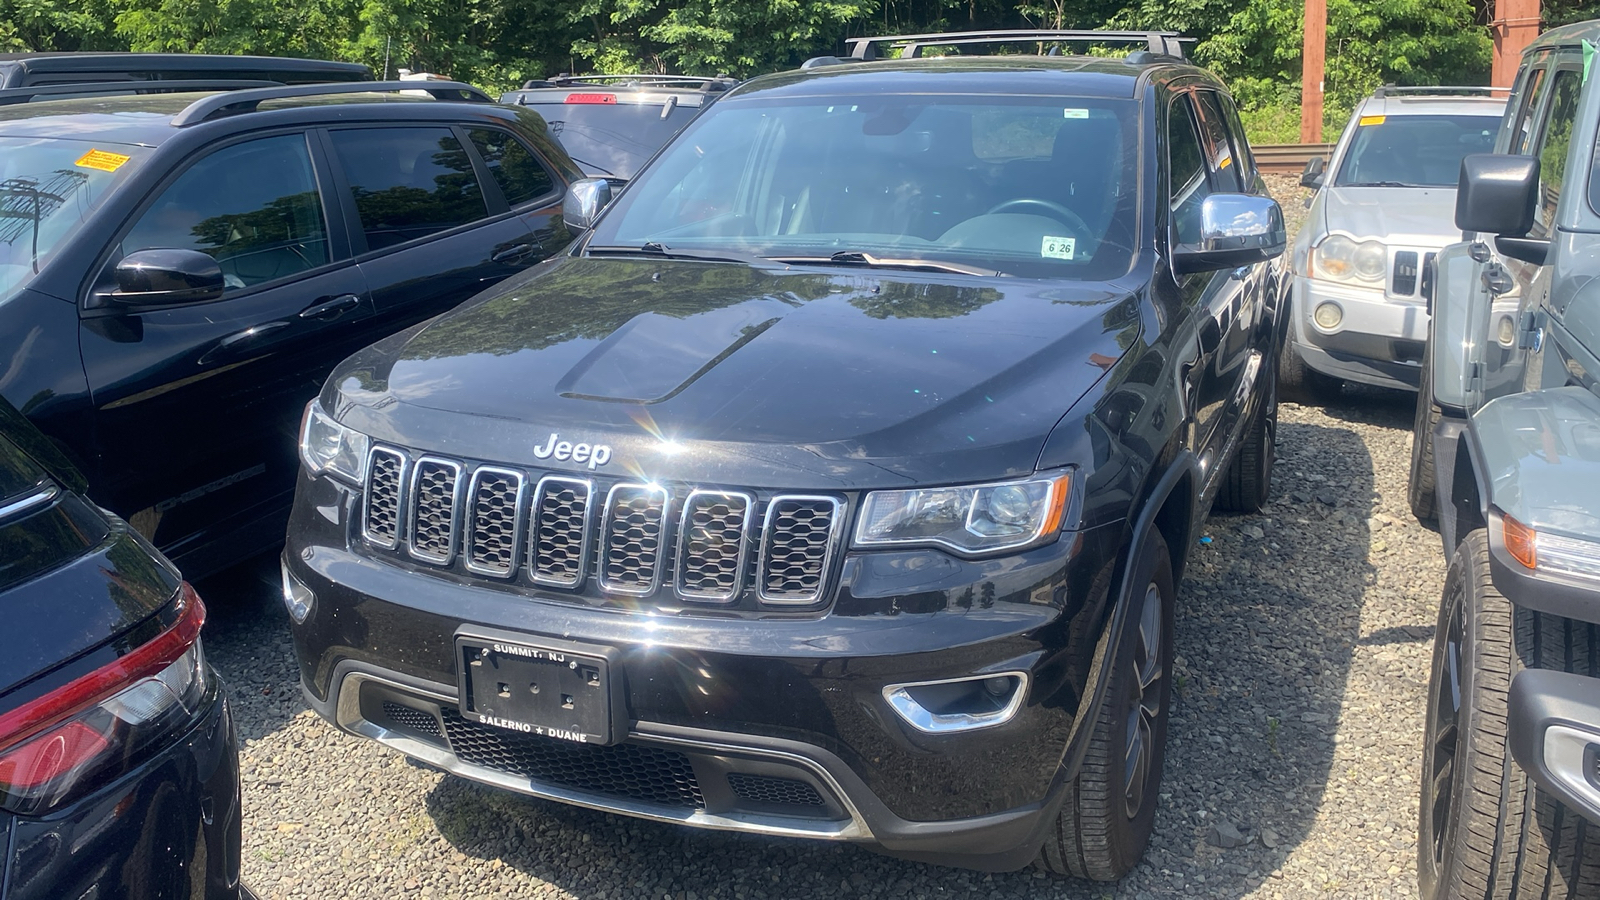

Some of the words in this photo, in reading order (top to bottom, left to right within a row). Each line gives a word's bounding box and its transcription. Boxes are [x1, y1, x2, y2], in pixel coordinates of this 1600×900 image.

[1048, 243, 1055, 252] 6
[1059, 243, 1071, 253] 26
[533, 433, 612, 471] Jeep
[548, 652, 565, 663] NJ
[479, 714, 531, 733] SALERNO
[548, 727, 587, 743] DUANE
